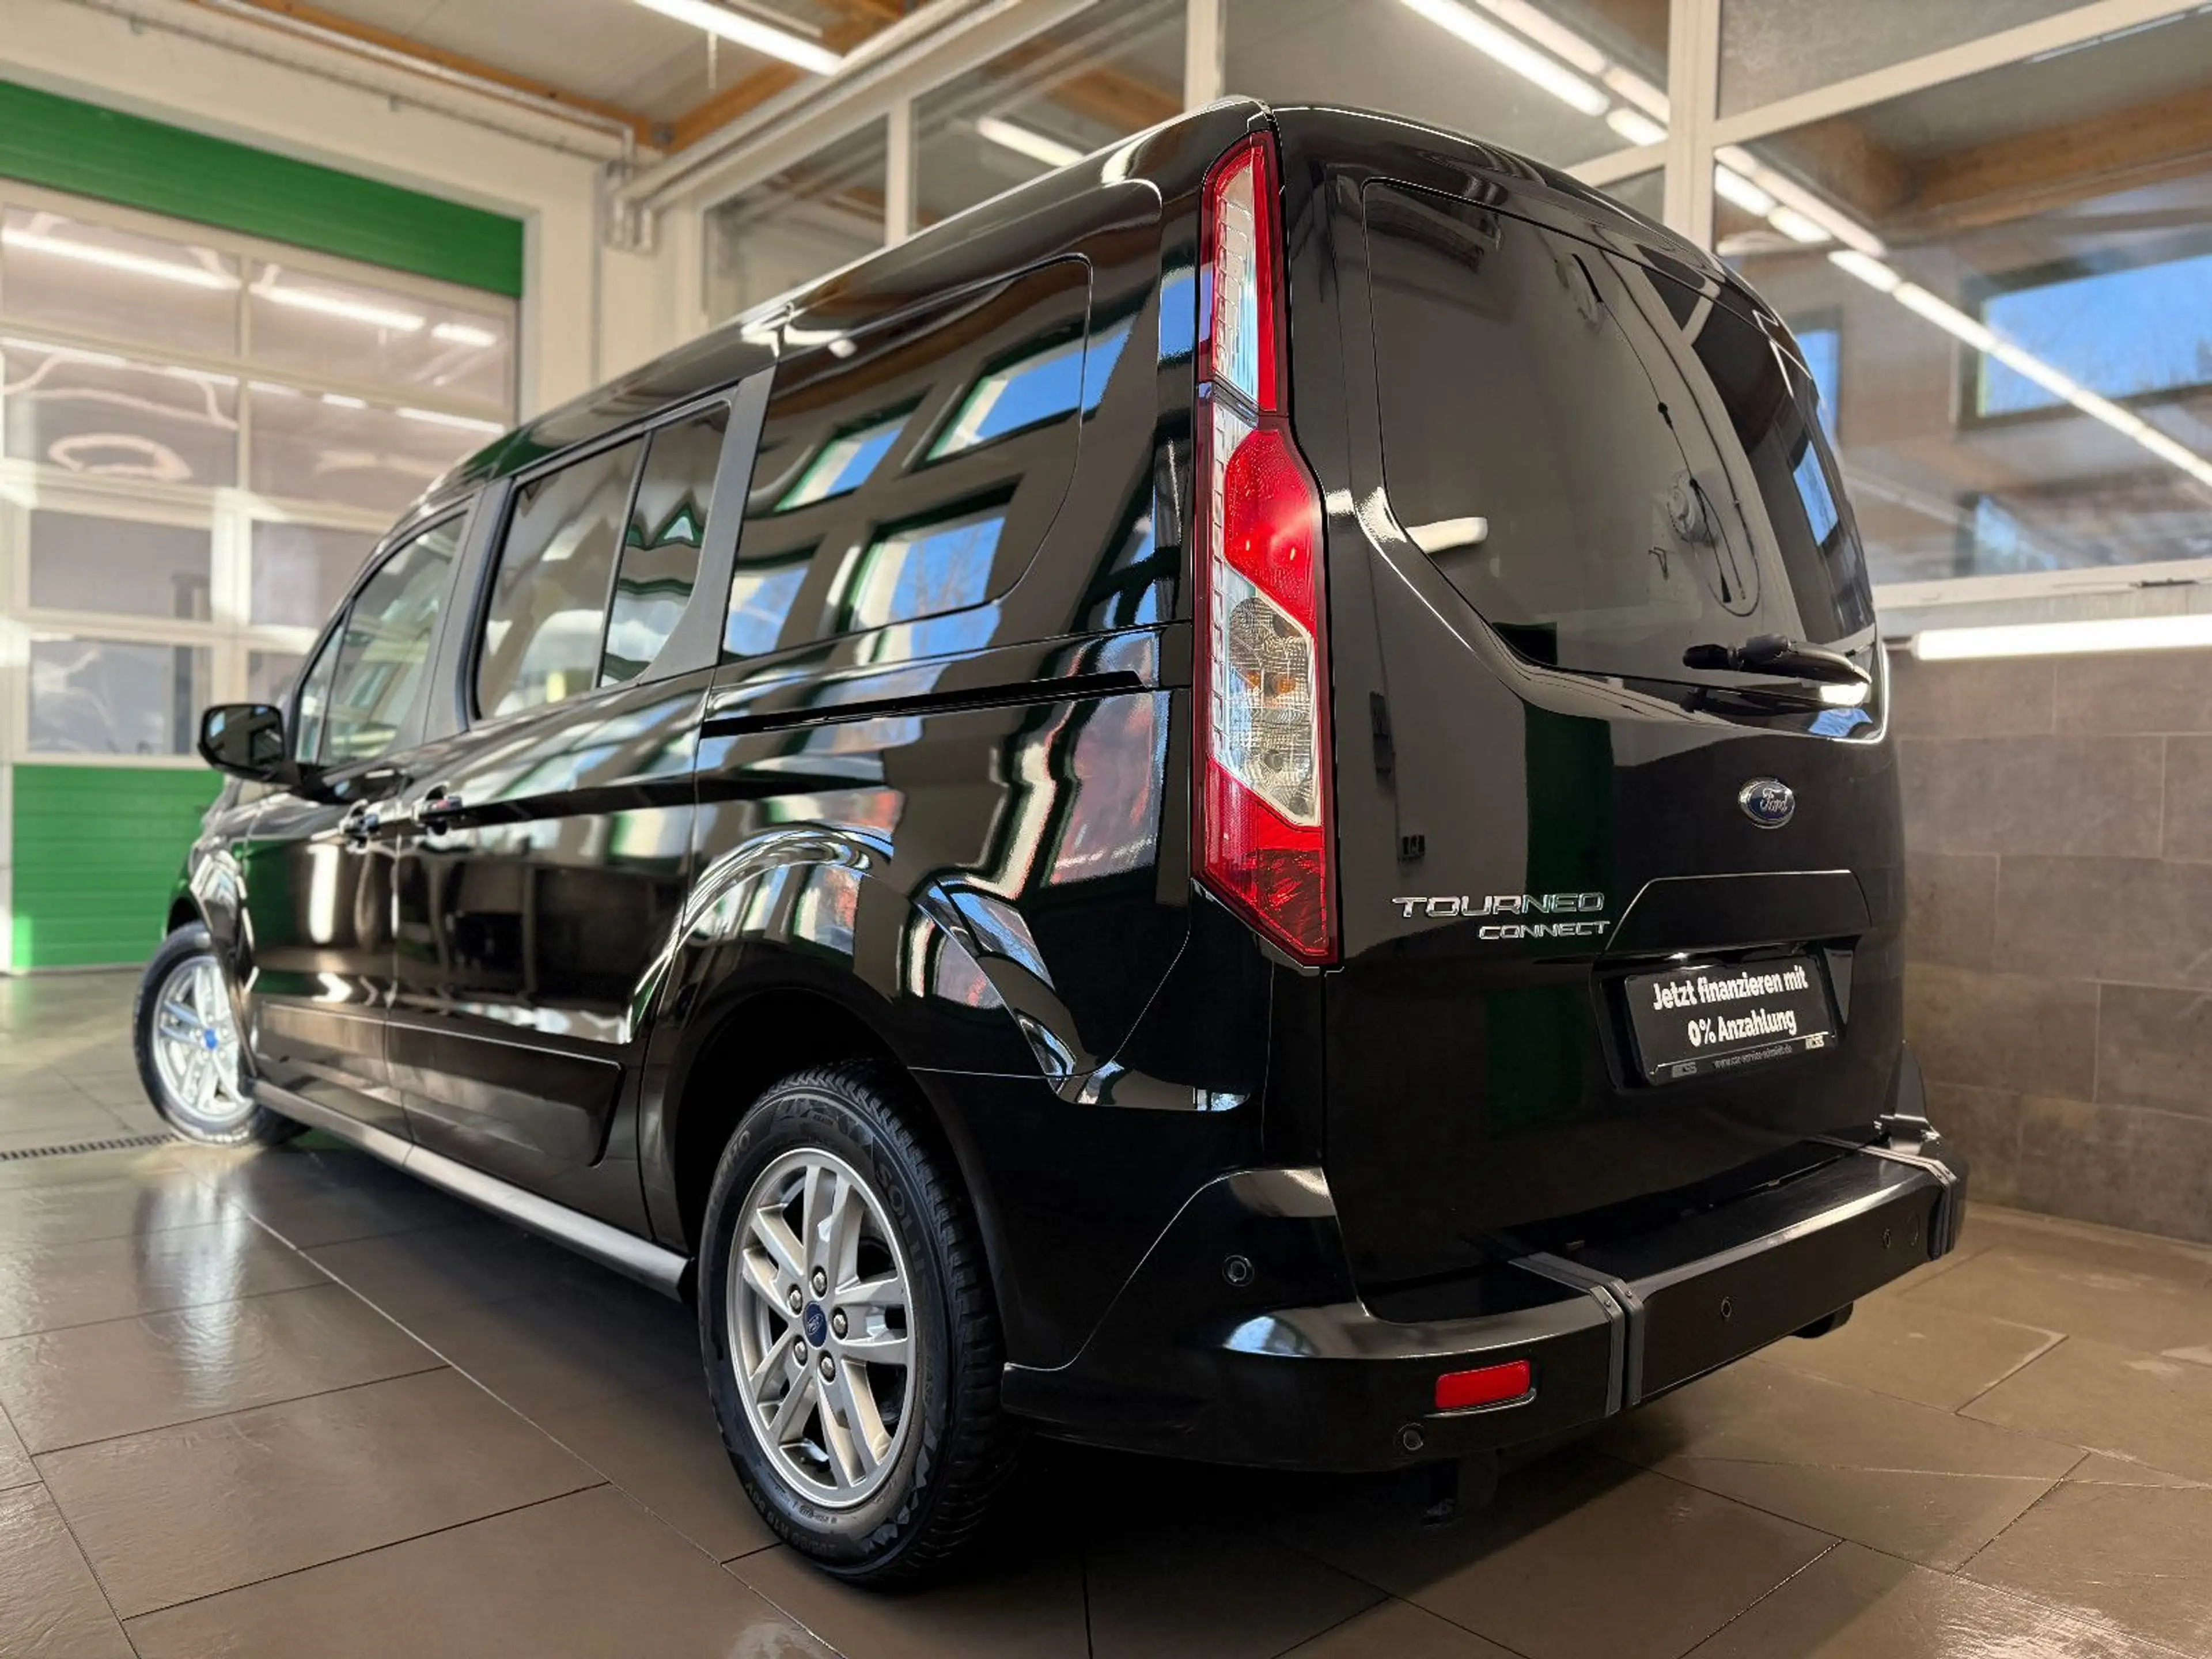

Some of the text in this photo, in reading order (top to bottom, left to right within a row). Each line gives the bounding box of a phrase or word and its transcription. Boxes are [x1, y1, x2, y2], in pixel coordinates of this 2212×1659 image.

[1392, 892, 1605, 918] TOURNEO
[1479, 921, 1611, 940] CONNECT
[1653, 964, 1809, 1010] Jetzt finanzieren mit
[1688, 1008, 1797, 1047] 0% Anzahlung
